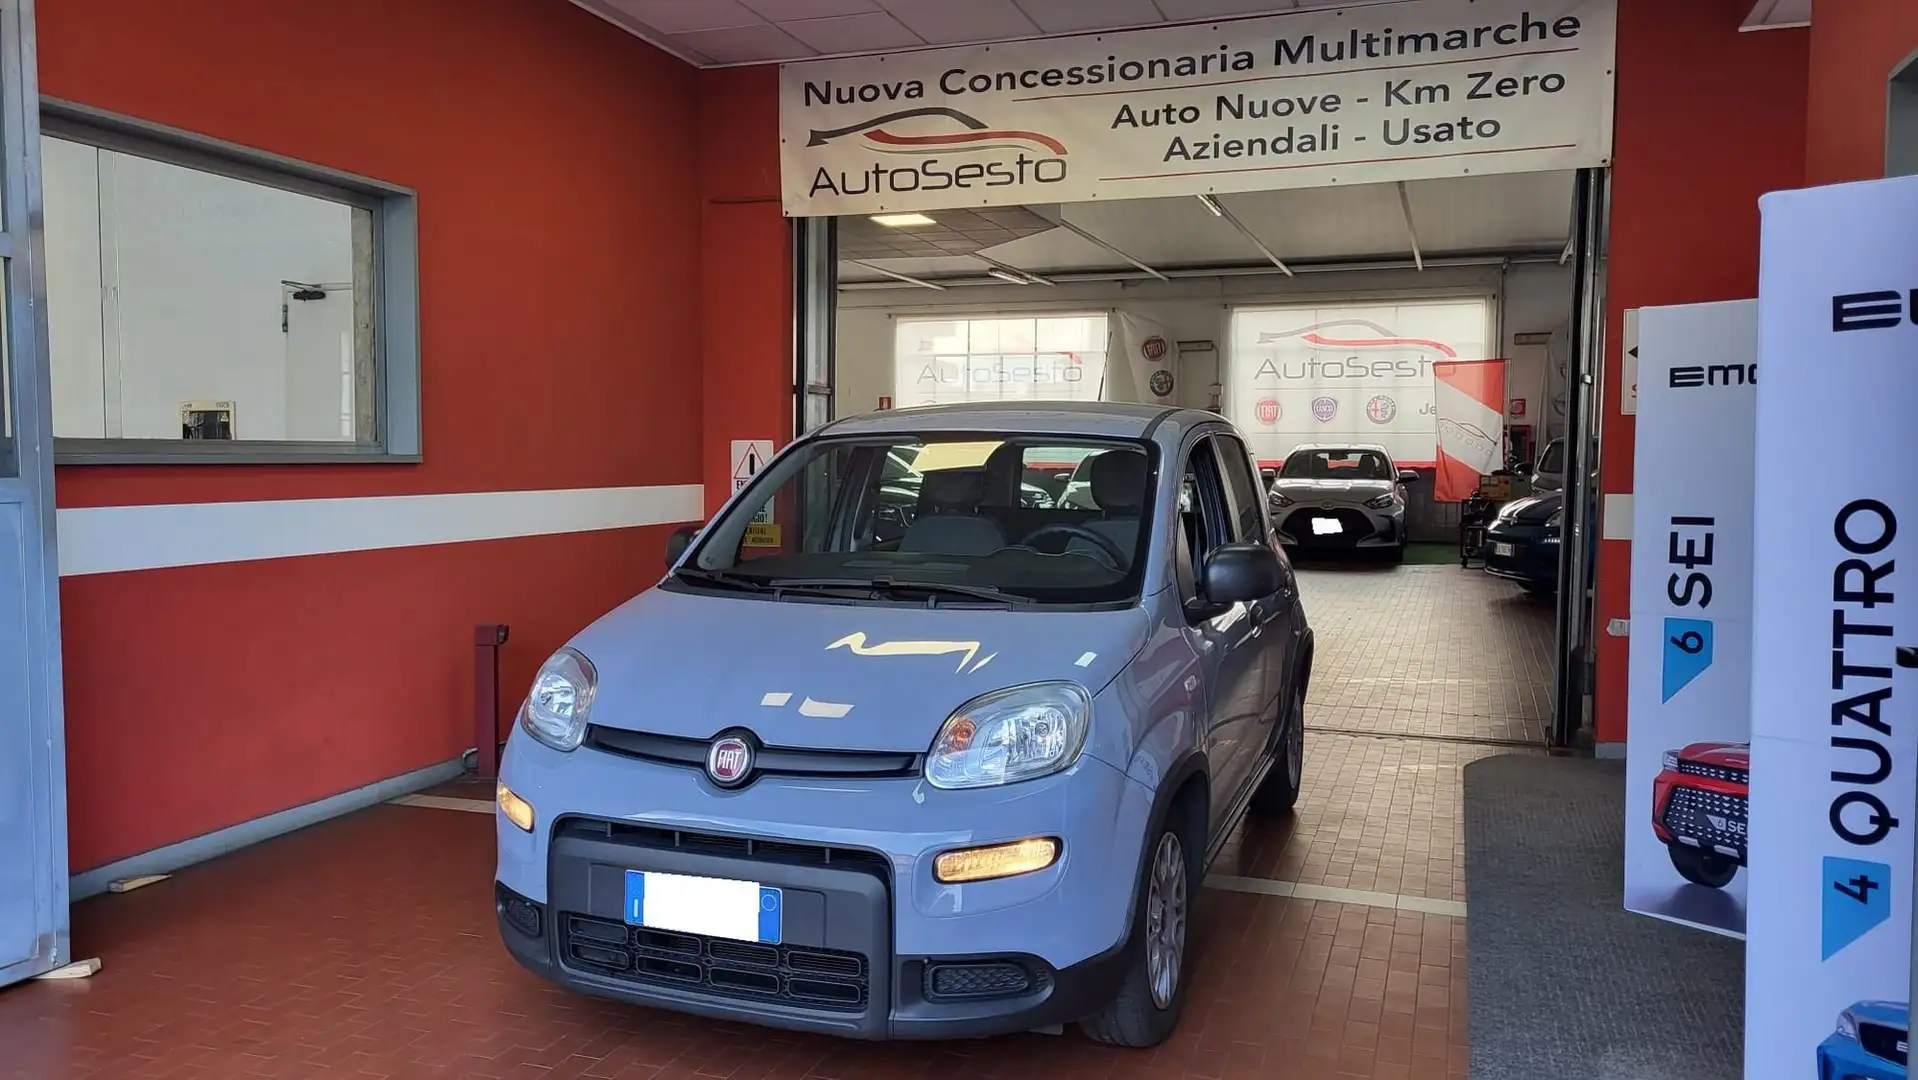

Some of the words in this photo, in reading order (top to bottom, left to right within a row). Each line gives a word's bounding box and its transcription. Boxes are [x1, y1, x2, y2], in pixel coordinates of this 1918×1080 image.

[804, 79, 925, 107] Nuova
[939, 44, 1255, 96] Concessionaria
[1274, 11, 1581, 67] Multimarche
[1110, 103, 1201, 130] Auto
[1215, 92, 1342, 121] Nuove
[1384, 78, 1450, 108] Km
[1465, 71, 1566, 101] Zero
[1163, 122, 1340, 163] Aziendali
[1383, 116, 1501, 146] Usato
[808, 152, 1067, 199] AutoSesto
[916, 359, 1083, 386] AutoSesto
[1418, 402, 1437, 415] Je
[1667, 516, 1715, 610] SEI
[1670, 630, 1705, 654] 6
[1829, 498, 1899, 846] QUATTRO
[717, 749, 742, 770] FIAT
[1728, 820, 1747, 836] SE
[1833, 874, 1879, 905] 4
